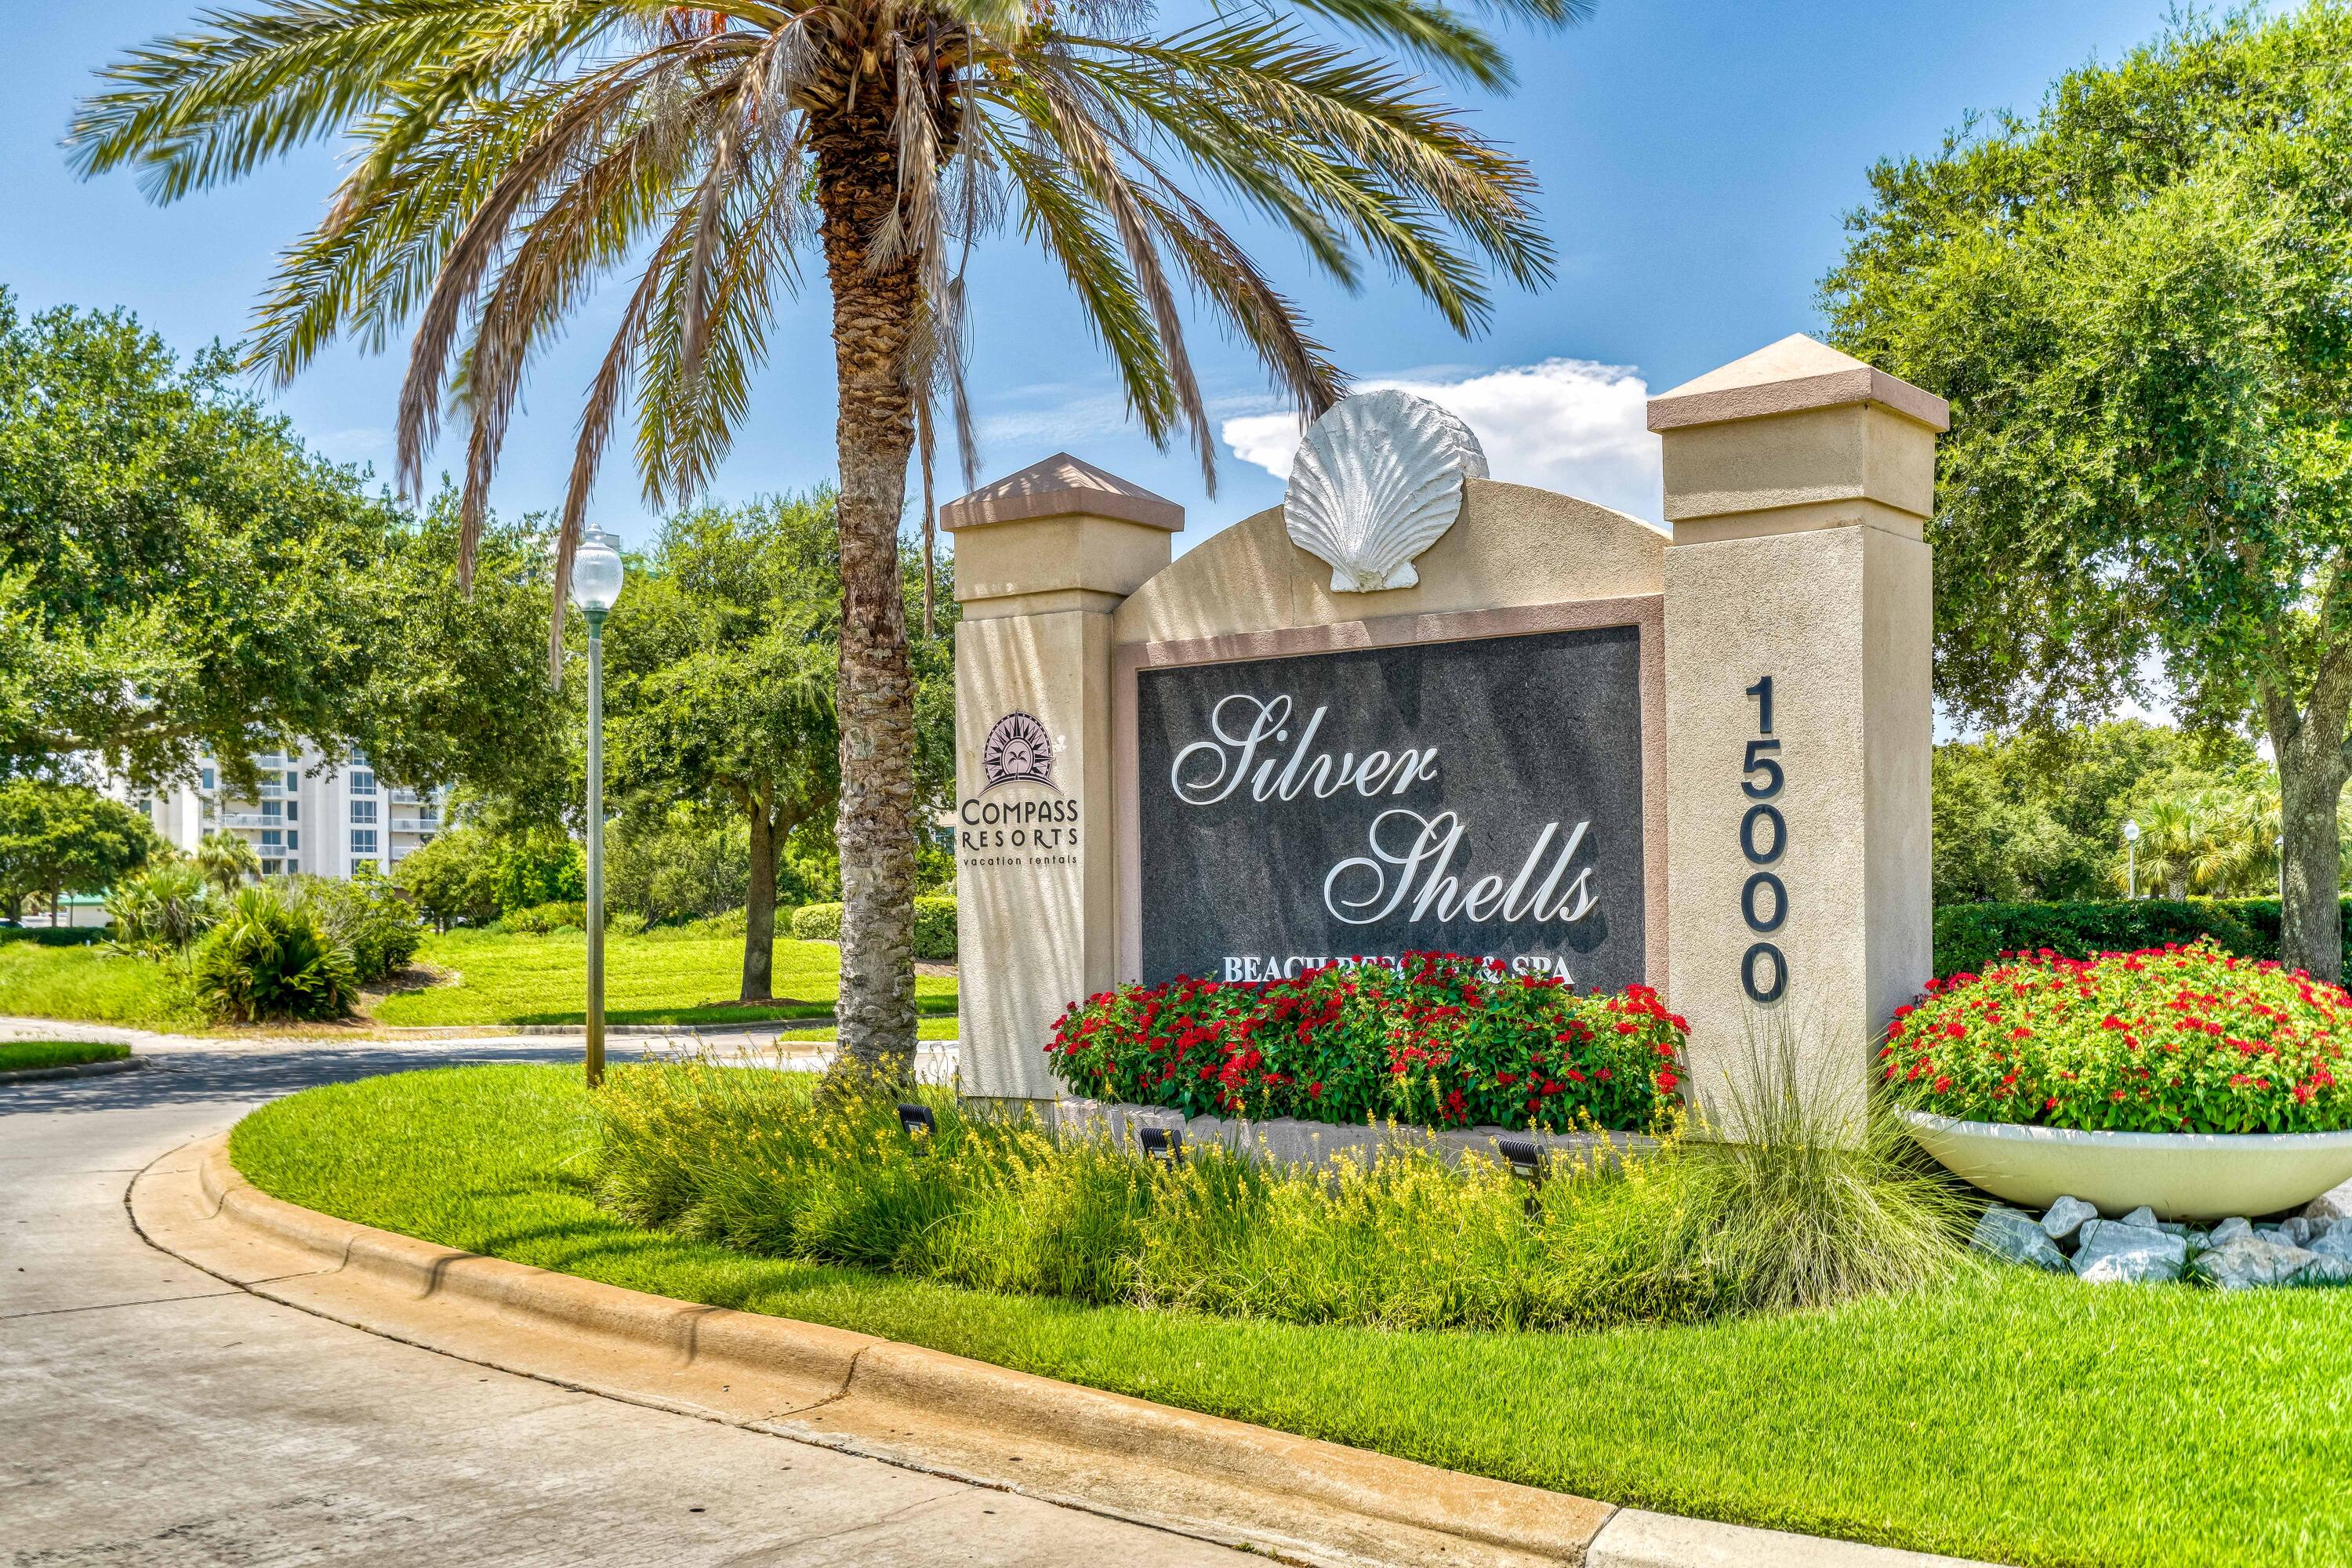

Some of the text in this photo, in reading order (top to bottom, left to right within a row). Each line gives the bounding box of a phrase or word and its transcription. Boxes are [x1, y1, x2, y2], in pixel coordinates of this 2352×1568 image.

[1171, 694, 1438, 805] Silver
[961, 798, 1079, 826] COMPASS
[961, 828, 1078, 851] RESORTS
[1740, 676, 1788, 1004] 15000
[964, 855, 1077, 866] vacation rentals
[1323, 809, 1599, 924] Shells
[1512, 956, 1576, 985] SPA
